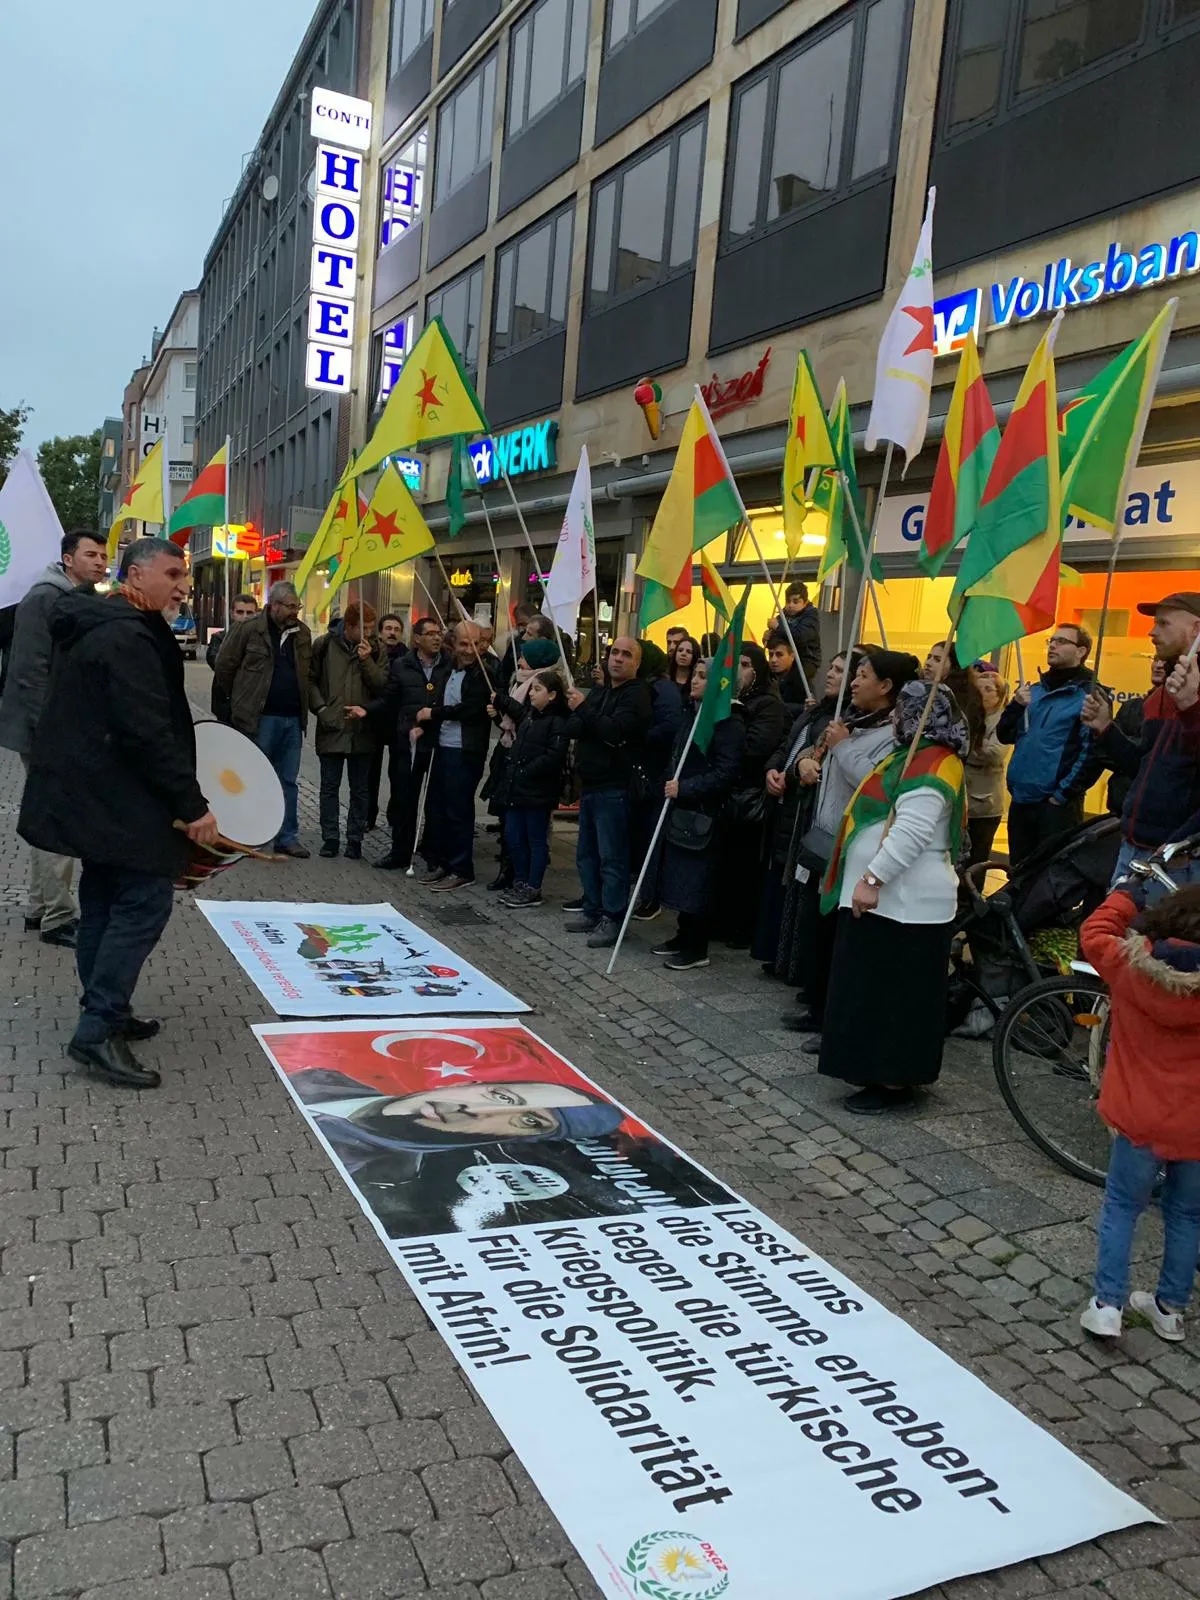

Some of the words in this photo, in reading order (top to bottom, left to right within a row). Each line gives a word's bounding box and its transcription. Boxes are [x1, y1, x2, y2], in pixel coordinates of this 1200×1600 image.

[316, 104, 370, 130] CONTI
[315, 150, 360, 386] HOTEL
[471, 419, 552, 481] ckWERK
[398, 1241, 469, 1286] mit
[534, 1226, 718, 1403] Kriegspolitik.
[711, 1209, 810, 1267] Lasst
[787, 1270, 864, 1316] uns
[427, 1289, 532, 1369] Afrin!
[467, 1233, 533, 1273] Für
[502, 1278, 567, 1321] die
[540, 1325, 733, 1514] Solidarität
[598, 1220, 694, 1293] Gegen
[674, 1297, 742, 1339] die
[724, 1341, 923, 1514] türkische
[656, 1215, 714, 1248] die
[698, 1251, 829, 1347] Stimme
[815, 1354, 1012, 1514] erheben-
[699, 1541, 729, 1573] DKGZ
